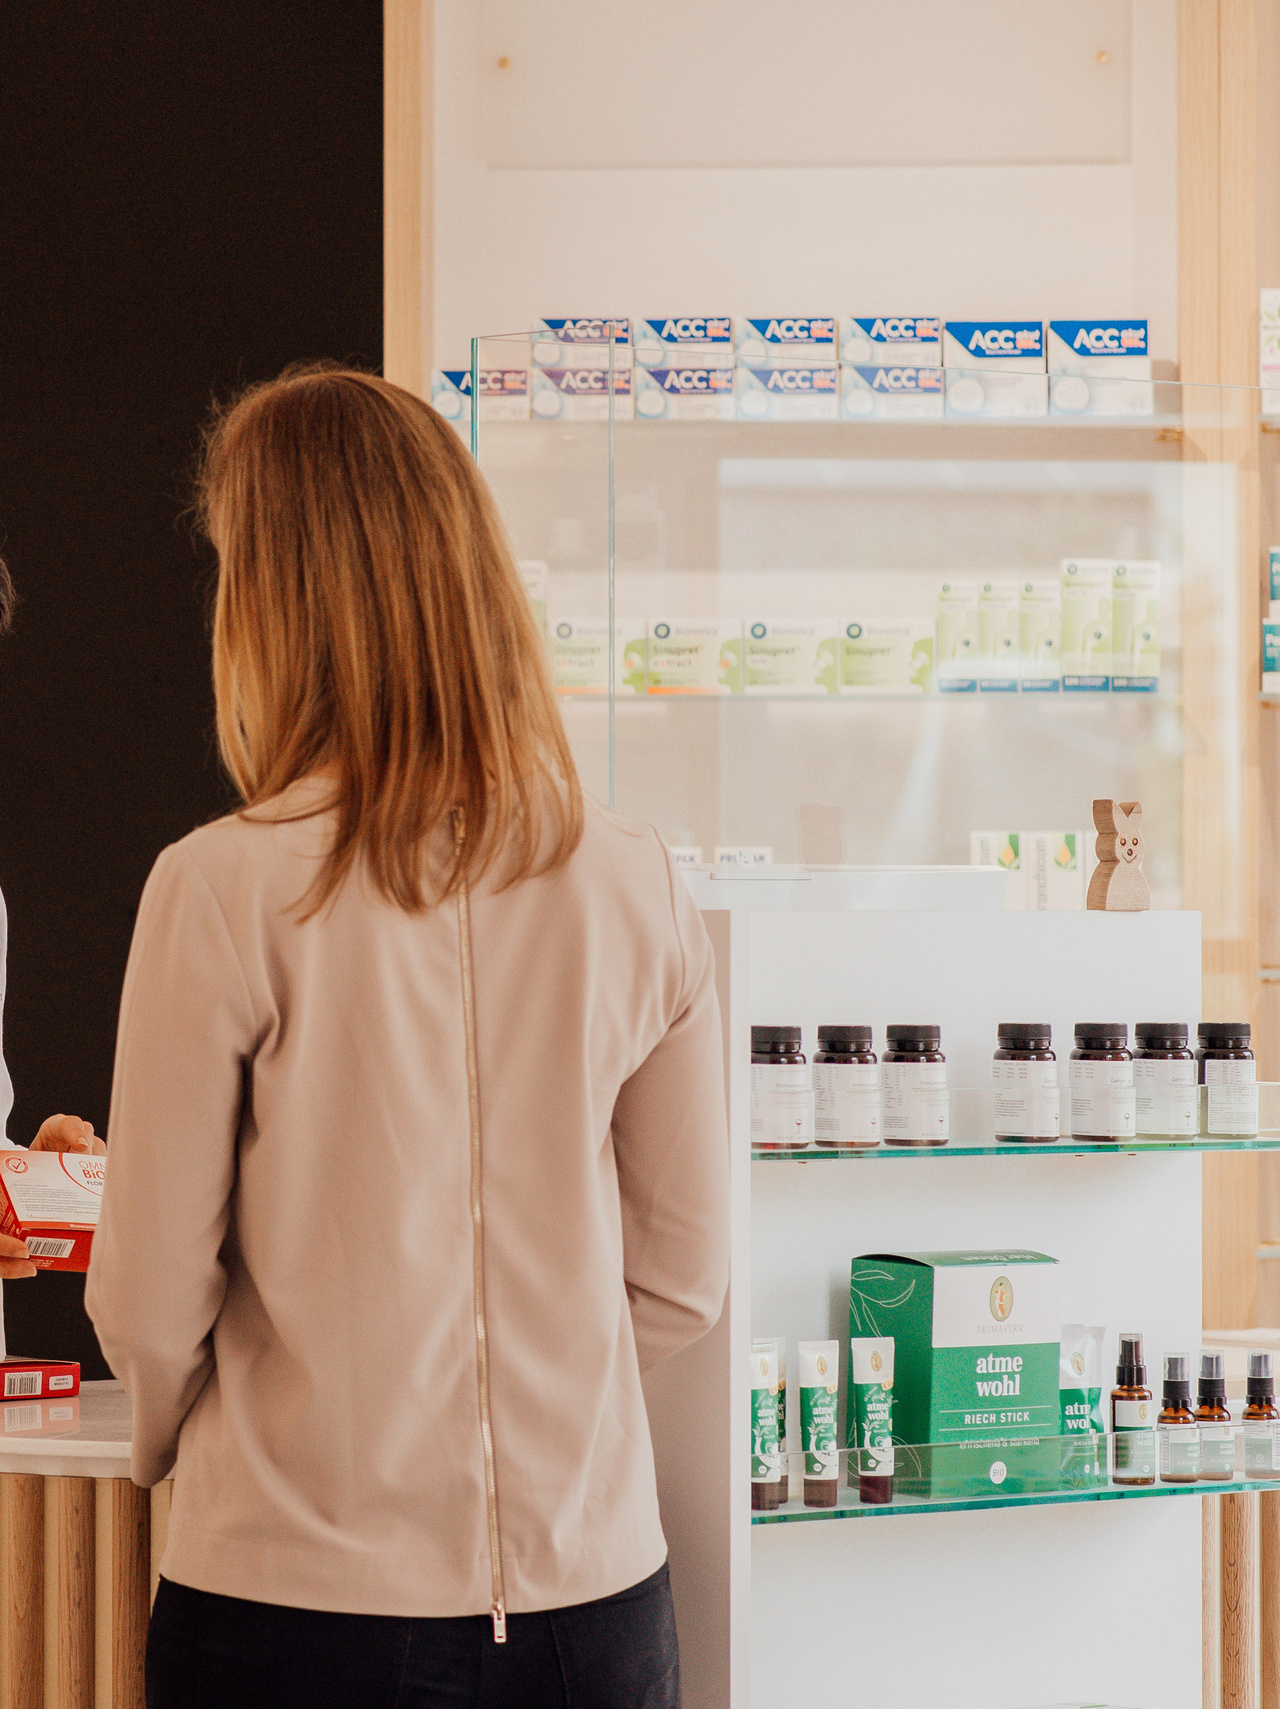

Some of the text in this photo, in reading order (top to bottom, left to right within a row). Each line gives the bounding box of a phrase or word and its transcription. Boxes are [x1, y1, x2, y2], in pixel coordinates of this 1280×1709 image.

[662, 320, 705, 337] ACC
[765, 320, 809, 338] ACC
[871, 319, 914, 338] ACC
[969, 329, 1014, 350] ACC
[1073, 328, 1119, 349] ACC
[560, 371, 603, 389] ACC
[664, 371, 707, 389] ACC
[768, 370, 811, 389] ACC
[873, 369, 916, 388] ACC
[79, 1161, 106, 1171] OMN
[82, 1169, 106, 1180] BiO
[975, 1353, 1024, 1374] atme
[975, 1373, 1021, 1397] wohl
[812, 1405, 834, 1415] atme
[866, 1402, 889, 1412] atme
[758, 1417, 777, 1426] wohl
[813, 1414, 834, 1424] wohl
[867, 1411, 889, 1421] wohl
[964, 1411, 1030, 1425] RIECH STICK
[992, 1468, 1004, 1477] BIO
